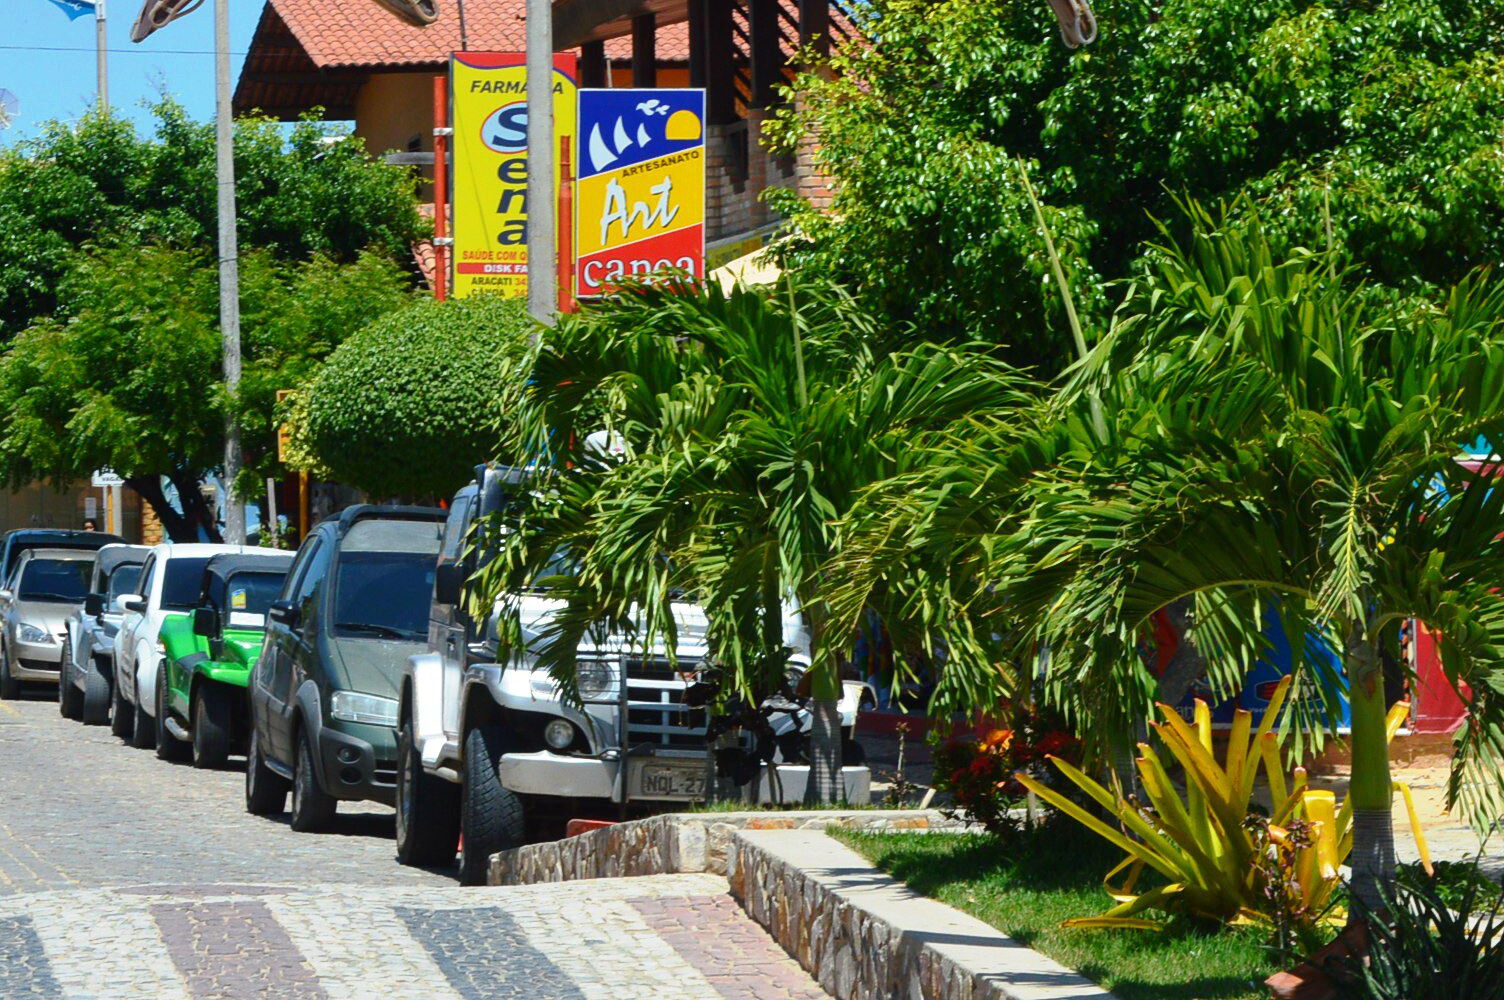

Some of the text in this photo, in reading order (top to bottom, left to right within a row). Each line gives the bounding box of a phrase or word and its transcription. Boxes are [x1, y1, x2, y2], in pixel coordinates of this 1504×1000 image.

[470, 80, 564, 95] FARMAA
[622, 150, 700, 178] ARTESANATO
[600, 175, 680, 246] Art
[496, 250, 517, 260] COM
[484, 264, 512, 273] DISK
[471, 277, 512, 285] ARACATI
